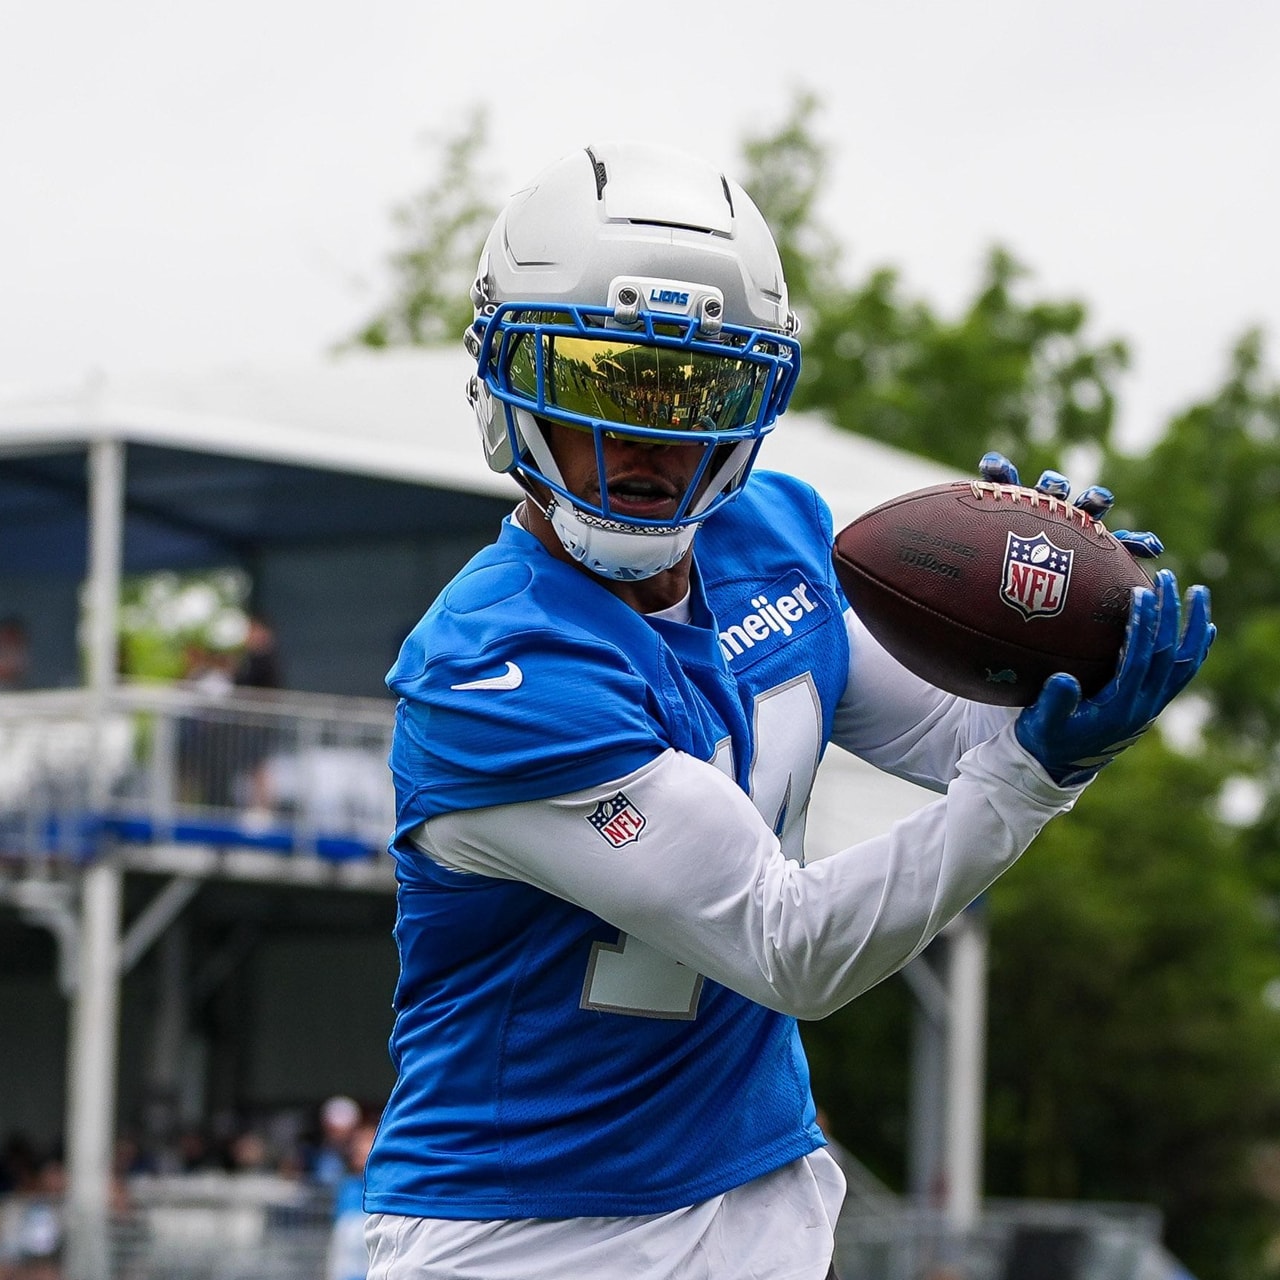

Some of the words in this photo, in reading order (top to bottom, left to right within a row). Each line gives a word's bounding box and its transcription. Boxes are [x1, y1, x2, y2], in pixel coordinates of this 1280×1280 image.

[650, 288, 689, 306] LIONS
[1006, 563, 1059, 609] NFL
[719, 582, 816, 662] meijer
[602, 809, 642, 845] NFL
